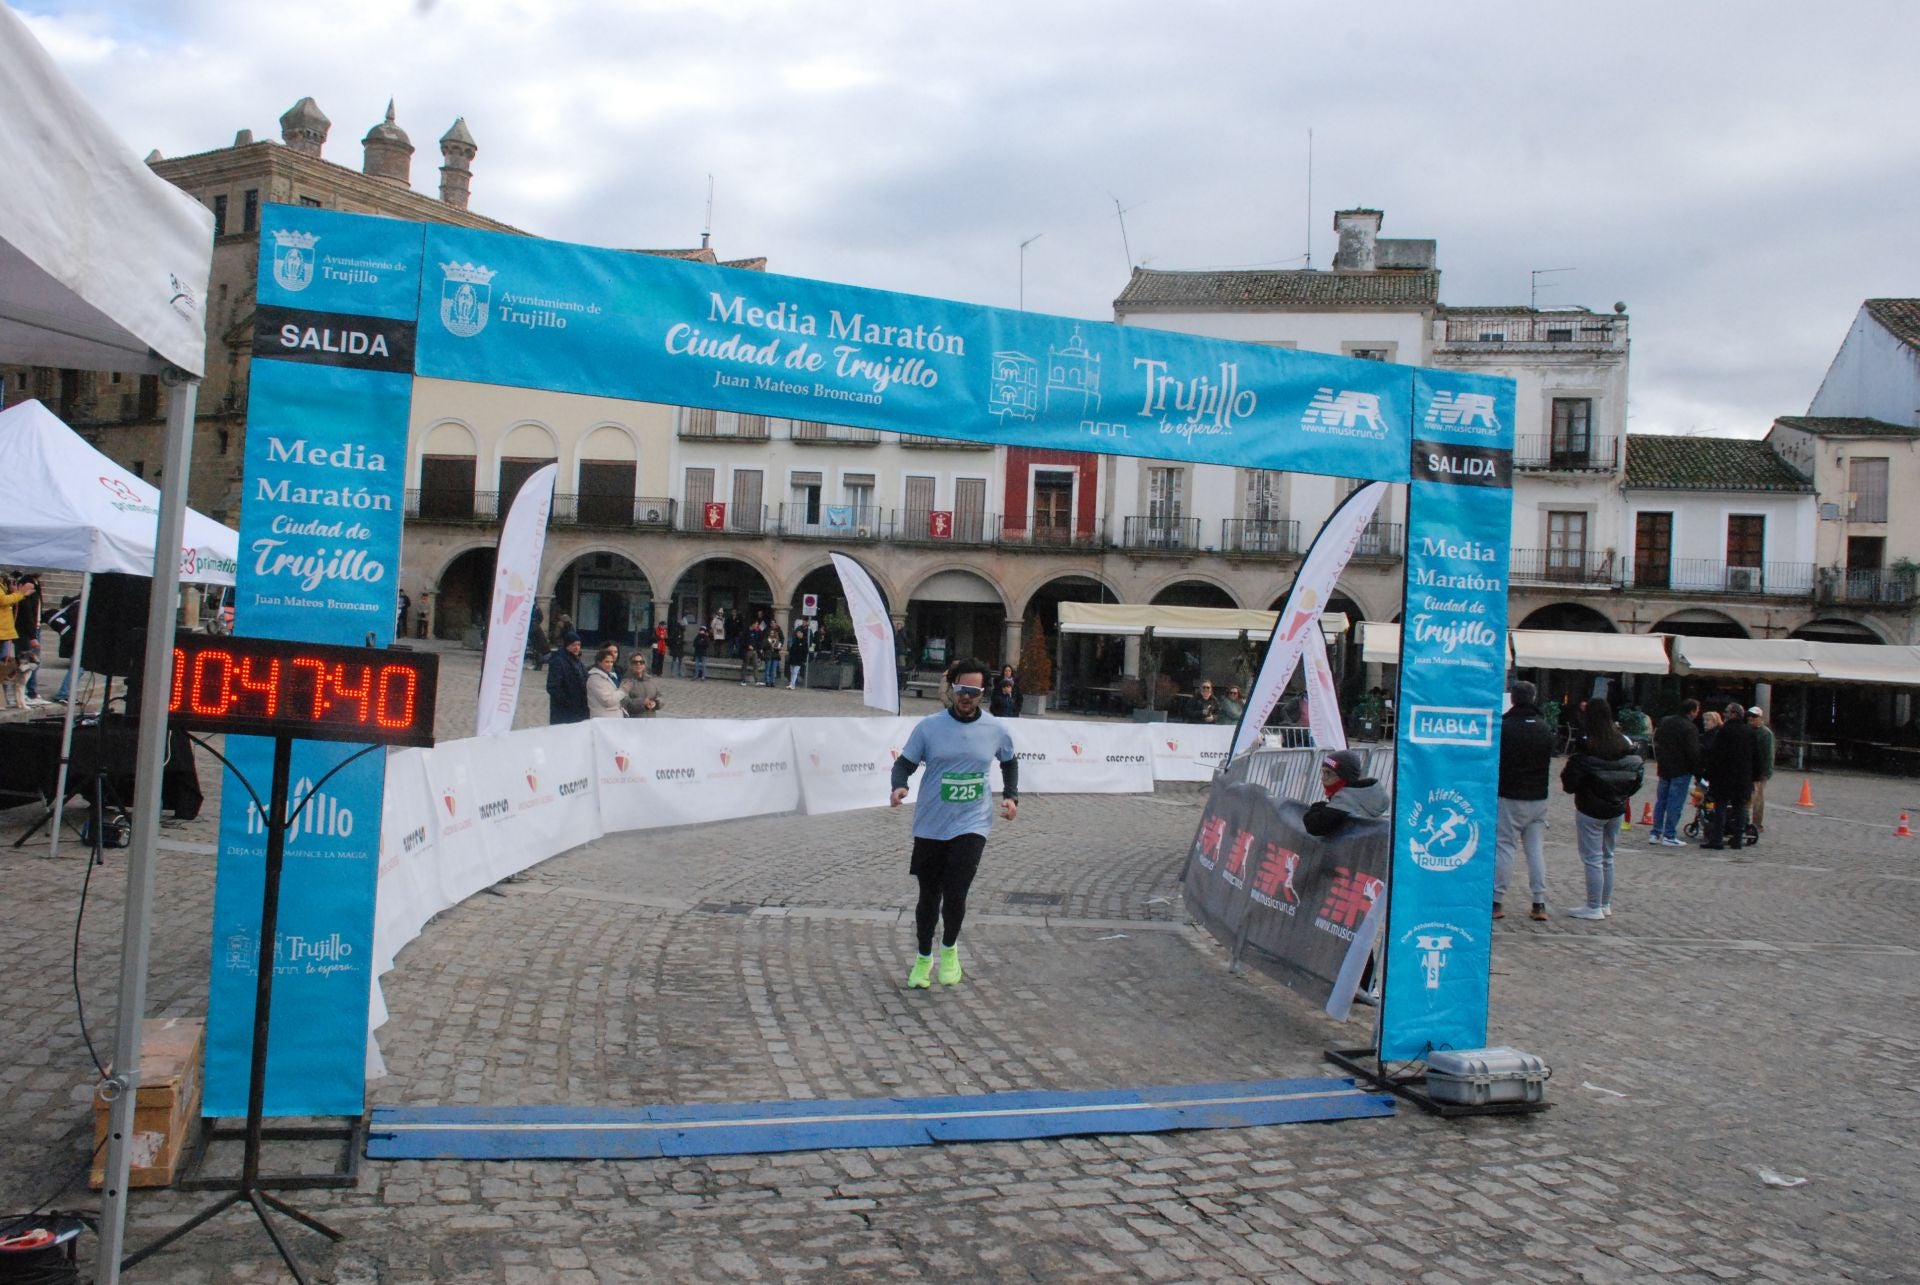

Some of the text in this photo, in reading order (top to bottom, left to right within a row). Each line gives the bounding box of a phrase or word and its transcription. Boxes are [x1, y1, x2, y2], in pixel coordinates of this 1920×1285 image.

[322, 266, 378, 284] Trujillo
[323, 254, 407, 272] Ayuntamiento de
[501, 291, 602, 314] Ayuntamiento de
[499, 306, 567, 329] Trujillo
[707, 292, 966, 356] Media Maratón
[280, 324, 389, 357] SALIDA
[665, 323, 938, 393] Ciudad de Trujillo
[713, 371, 883, 405] Juan Mateos Broncano
[1134, 356, 1257, 429] Trujillo
[1160, 413, 1173, 433] te
[1301, 424, 1385, 440] www.musicrun.es
[1423, 422, 1497, 436] www.musicrun.es
[266, 437, 386, 471] Media
[1428, 453, 1496, 477] SALIDA
[256, 478, 392, 511] Maratón
[272, 514, 371, 540] Ciudad de
[1422, 537, 1496, 561] Media
[196, 557, 237, 574] primaflo
[252, 538, 384, 592] Trujillo
[1416, 567, 1501, 592] Maratón
[255, 594, 379, 611] Juan Mateos Broncano
[1424, 595, 1486, 613] Ciudad de
[1413, 613, 1496, 654] Trujillo
[1421, 718, 1479, 735] HABLA
[949, 785, 977, 800] 225
[247, 776, 353, 844] trjillo
[1408, 788, 1475, 827] Club Atletismo
[227, 846, 249, 856] DEJA
[324, 850, 335, 858] LA
[286, 933, 352, 961] Trujillo
